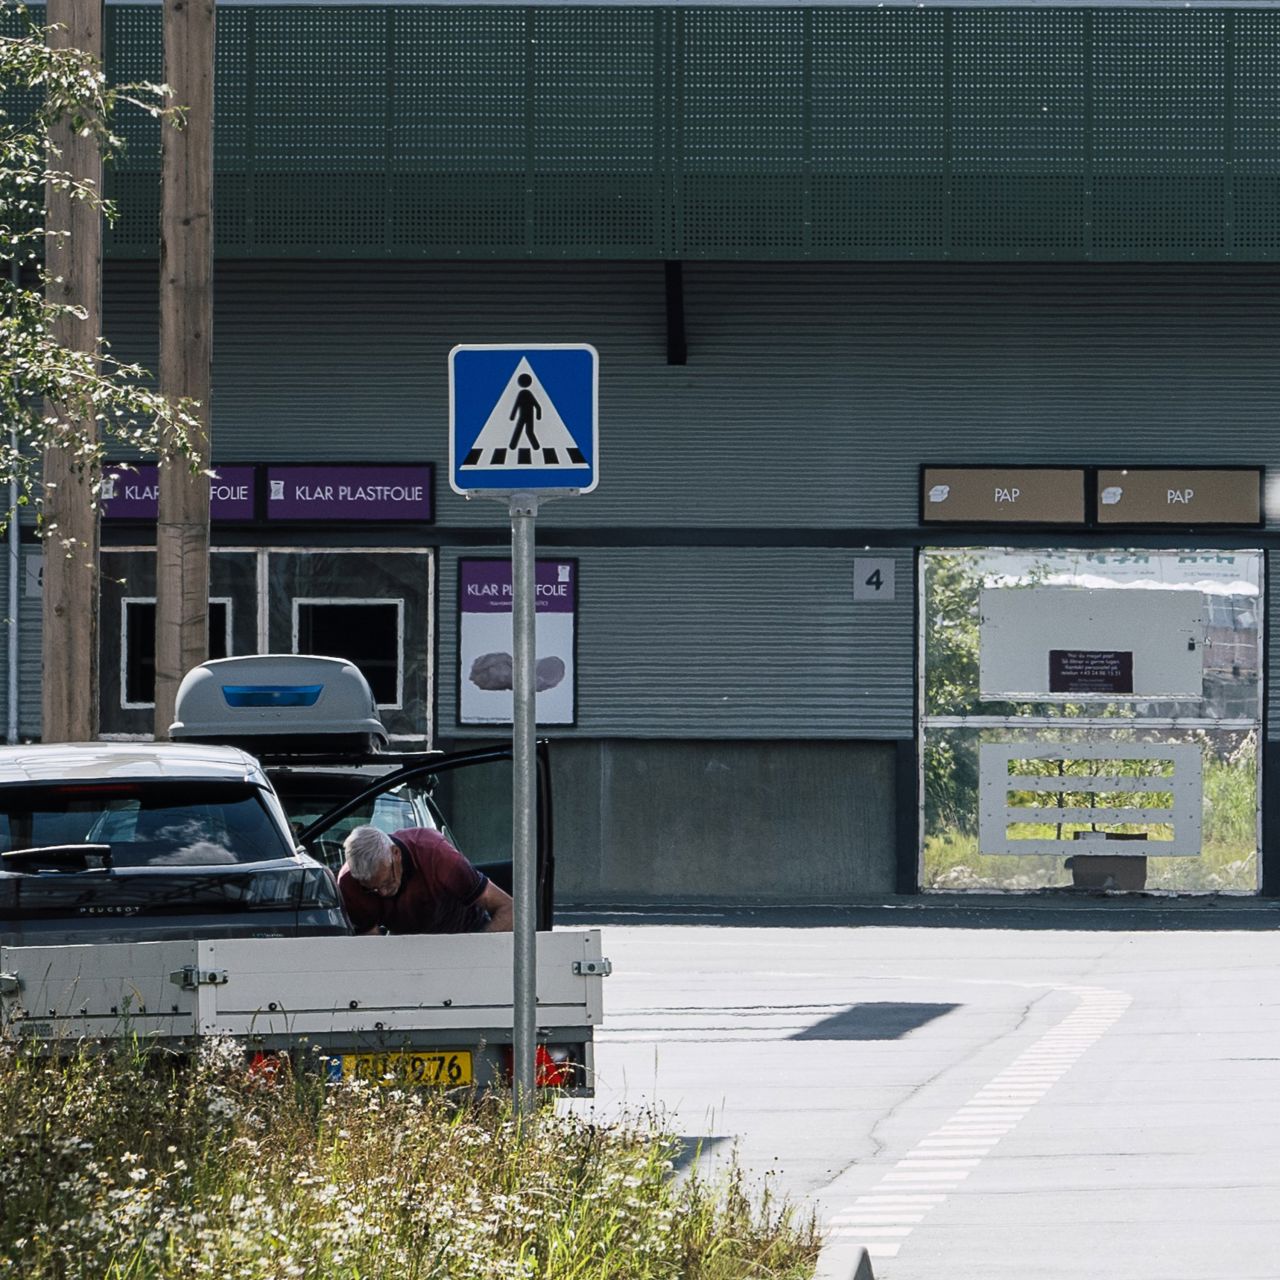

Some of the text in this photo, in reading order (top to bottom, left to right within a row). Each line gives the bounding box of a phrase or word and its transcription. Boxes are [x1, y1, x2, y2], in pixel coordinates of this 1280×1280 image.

[209, 486, 249, 501] FOLIE
[295, 486, 423, 501] KLAR PLASTFOLIE
[994, 488, 1020, 502] PAP
[1167, 489, 1194, 504] PAP
[865, 569, 884, 591] 4
[467, 584, 568, 596] KLAR PLFOLIE
